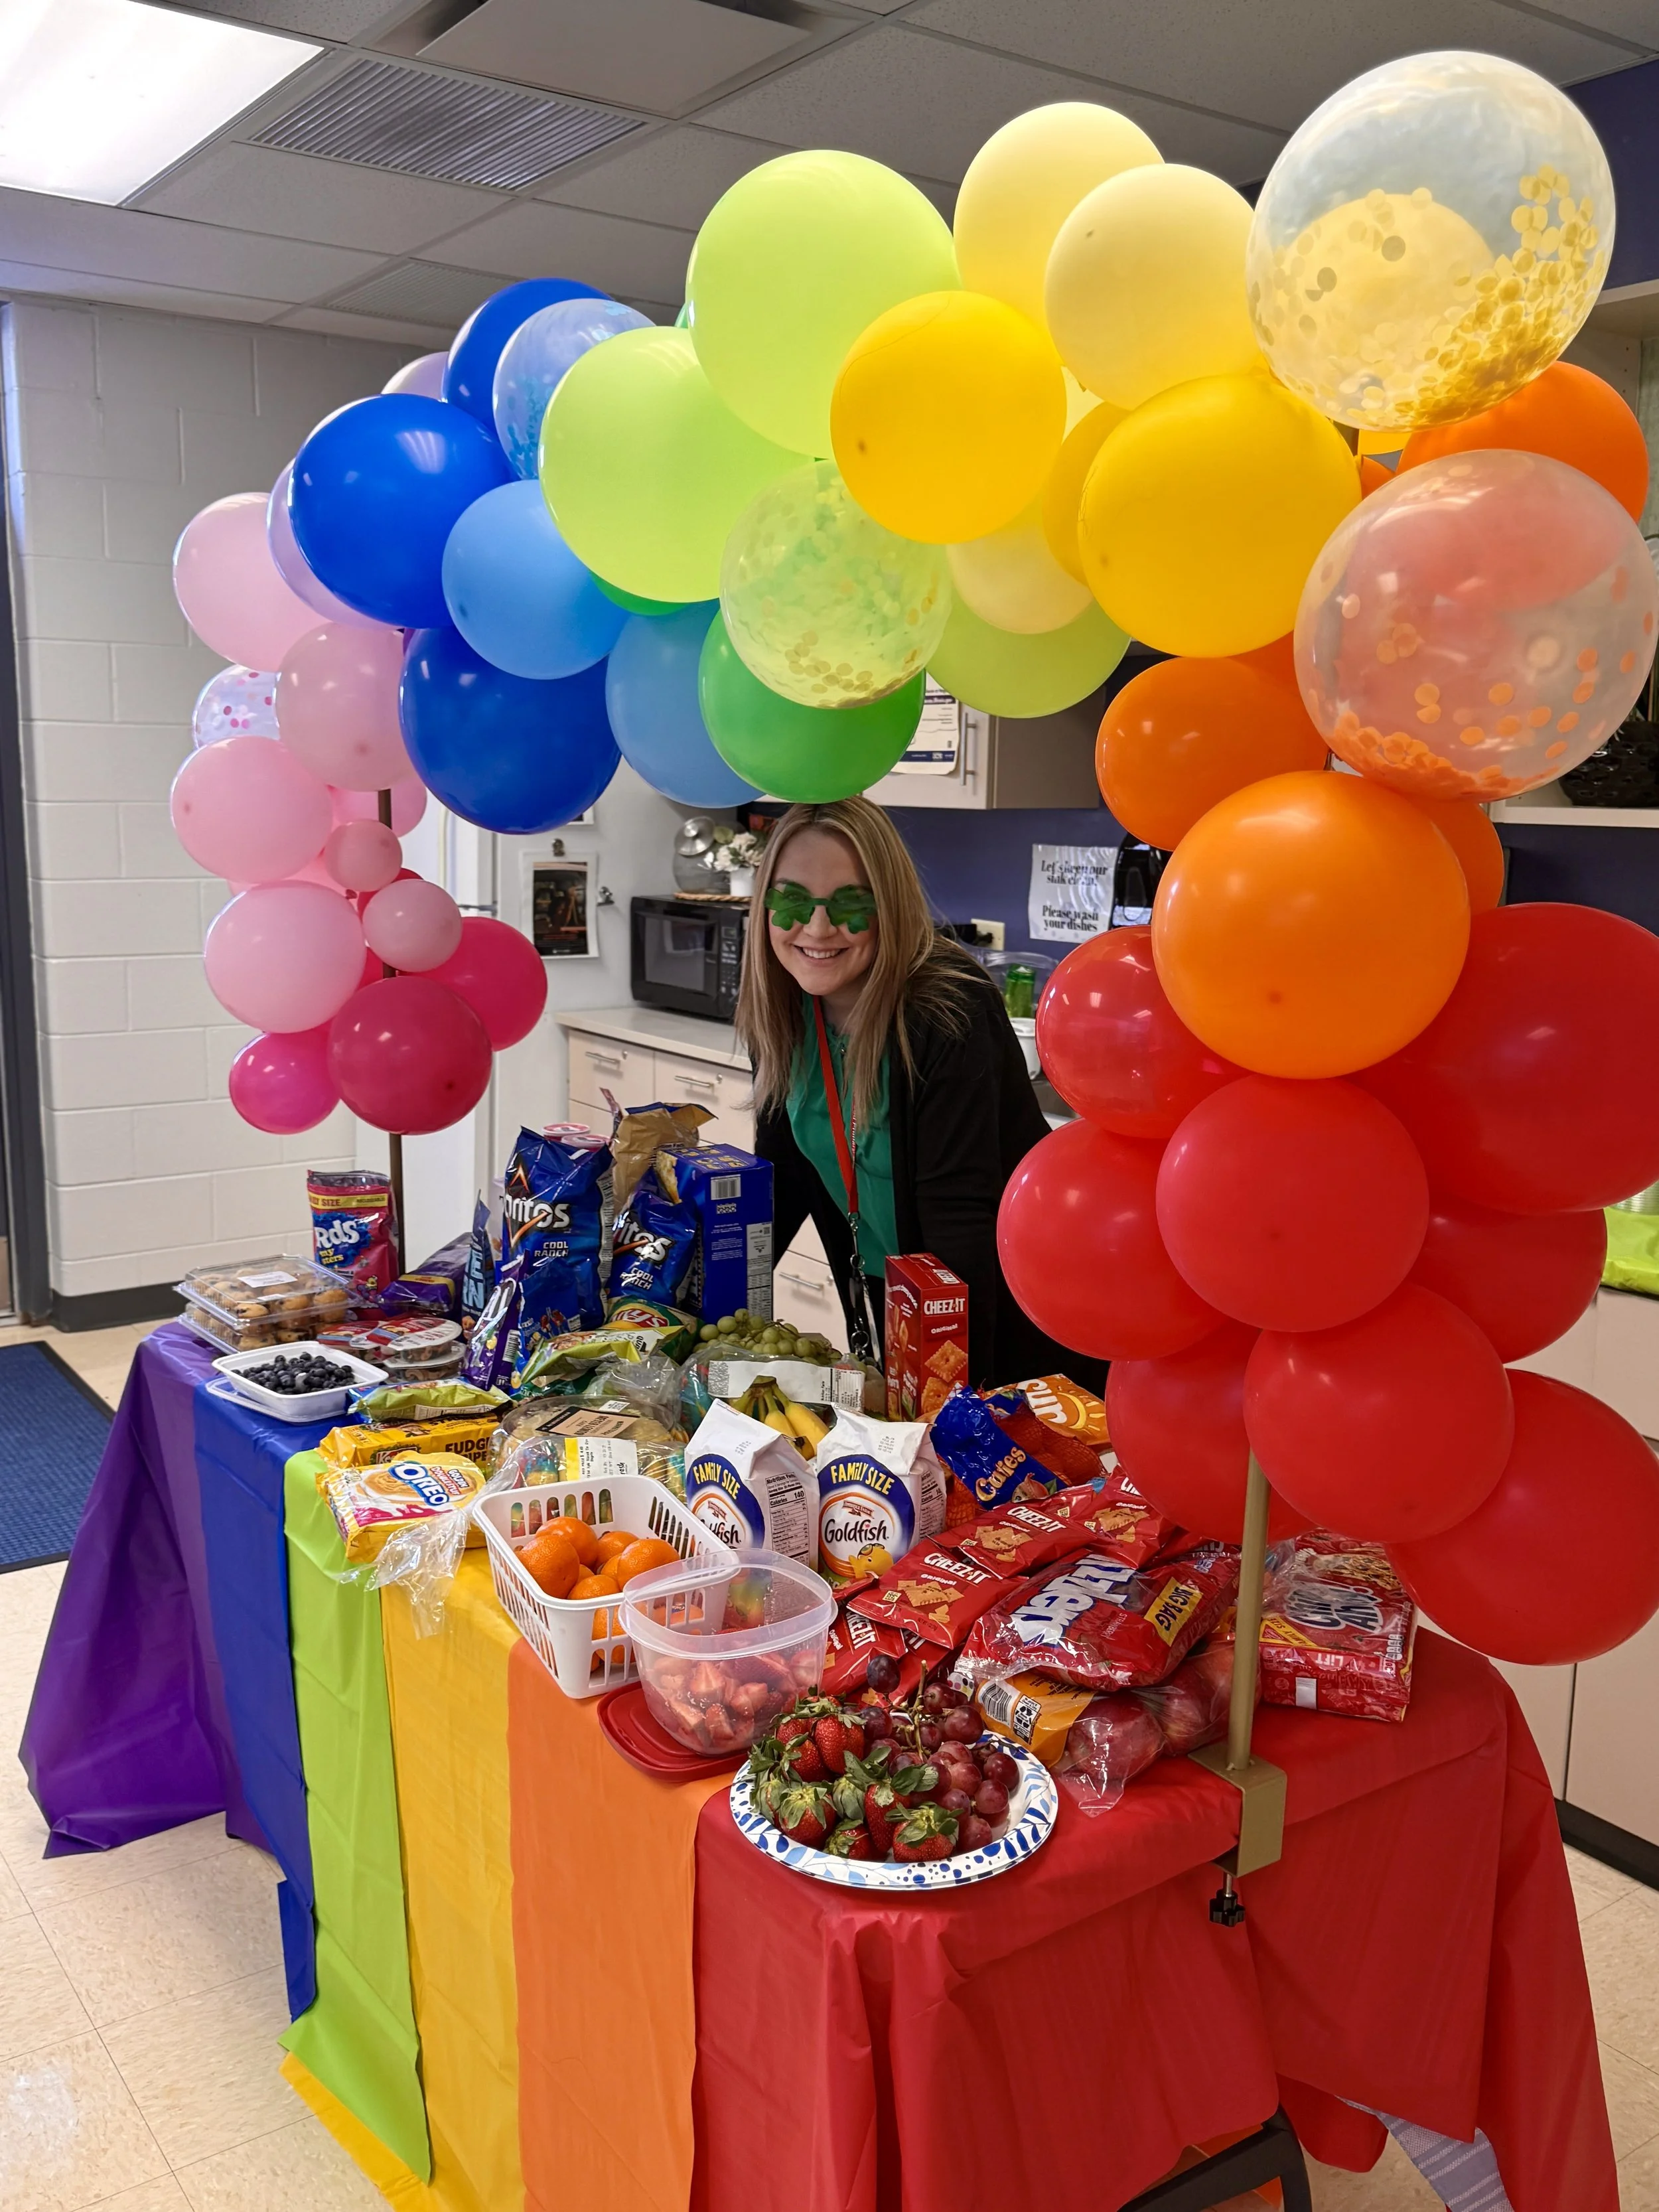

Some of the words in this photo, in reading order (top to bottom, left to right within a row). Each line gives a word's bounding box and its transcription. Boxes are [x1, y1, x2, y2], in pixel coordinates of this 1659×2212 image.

[1088, 866, 1108, 875] our
[1042, 905, 1071, 920] Please
[1074, 910, 1099, 921] wash
[1044, 919, 1066, 930] your
[1067, 919, 1098, 932] dishes
[543, 1240, 569, 1249] COOL
[631, 1267, 654, 1282] COOL
[924, 1297, 966, 1315] CHEEZ-IT
[1017, 1378, 1067, 1424] Sun
[395, 1463, 448, 1505] OREO
[448, 1469, 469, 1488] GOLDEN
[722, 1469, 740, 1500] SIZE
[766, 1474, 786, 1485] Nutrition
[865, 1467, 895, 1495] SIZE
[975, 1447, 1027, 1502] Cuties
[824, 1518, 888, 1544] Goldfish
[1007, 1506, 1067, 1533] CHEEZ-IT
[924, 1552, 991, 1584] CHEEZ-IT
[1169, 1586, 1194, 1606] BIG
[1155, 1601, 1183, 1631] BAG
